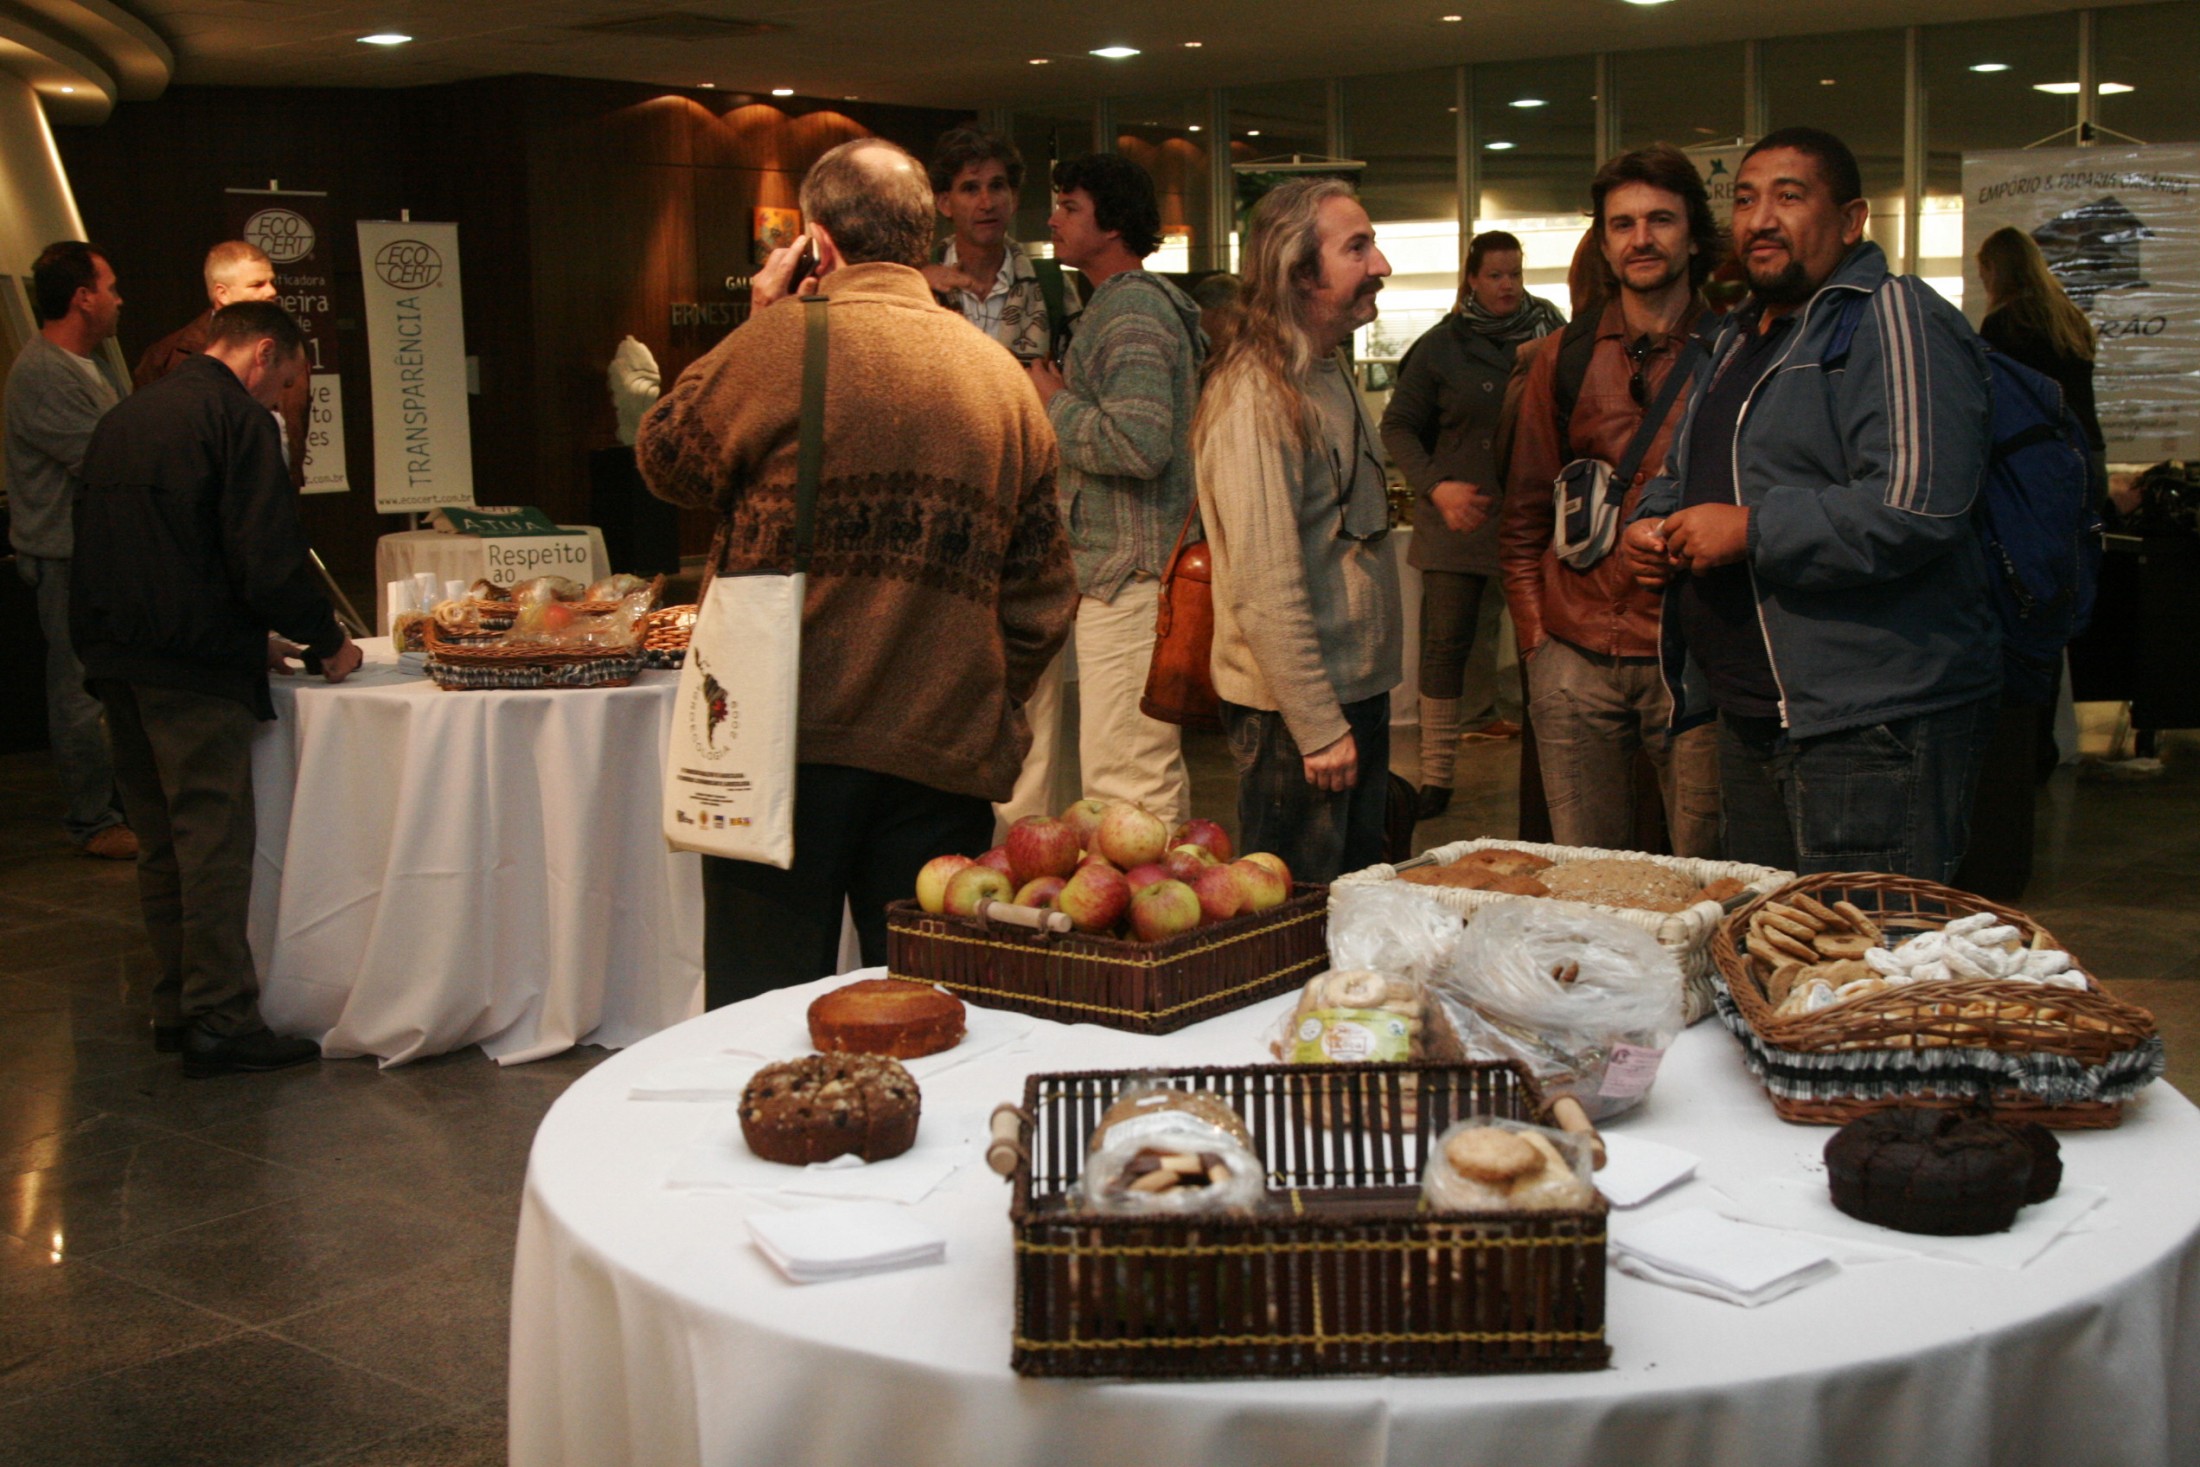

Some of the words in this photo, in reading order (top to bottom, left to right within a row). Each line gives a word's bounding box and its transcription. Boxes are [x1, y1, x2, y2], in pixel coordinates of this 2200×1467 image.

[1978, 174, 2041, 204] EMPÓRIO
[258, 216, 299, 236] ECO
[259, 235, 305, 255] CERT
[387, 246, 429, 265] ECO
[274, 275, 326, 286] tificadora
[388, 264, 435, 284] CERT
[2096, 313, 2167, 339] RÃO
[394, 295, 432, 488] TRANSPARÊNCIA
[311, 406, 332, 424] to
[308, 430, 330, 447] es
[377, 493, 474, 506] www.ecocert.com.br
[488, 543, 587, 570] Respeito
[493, 568, 516, 584] ao
